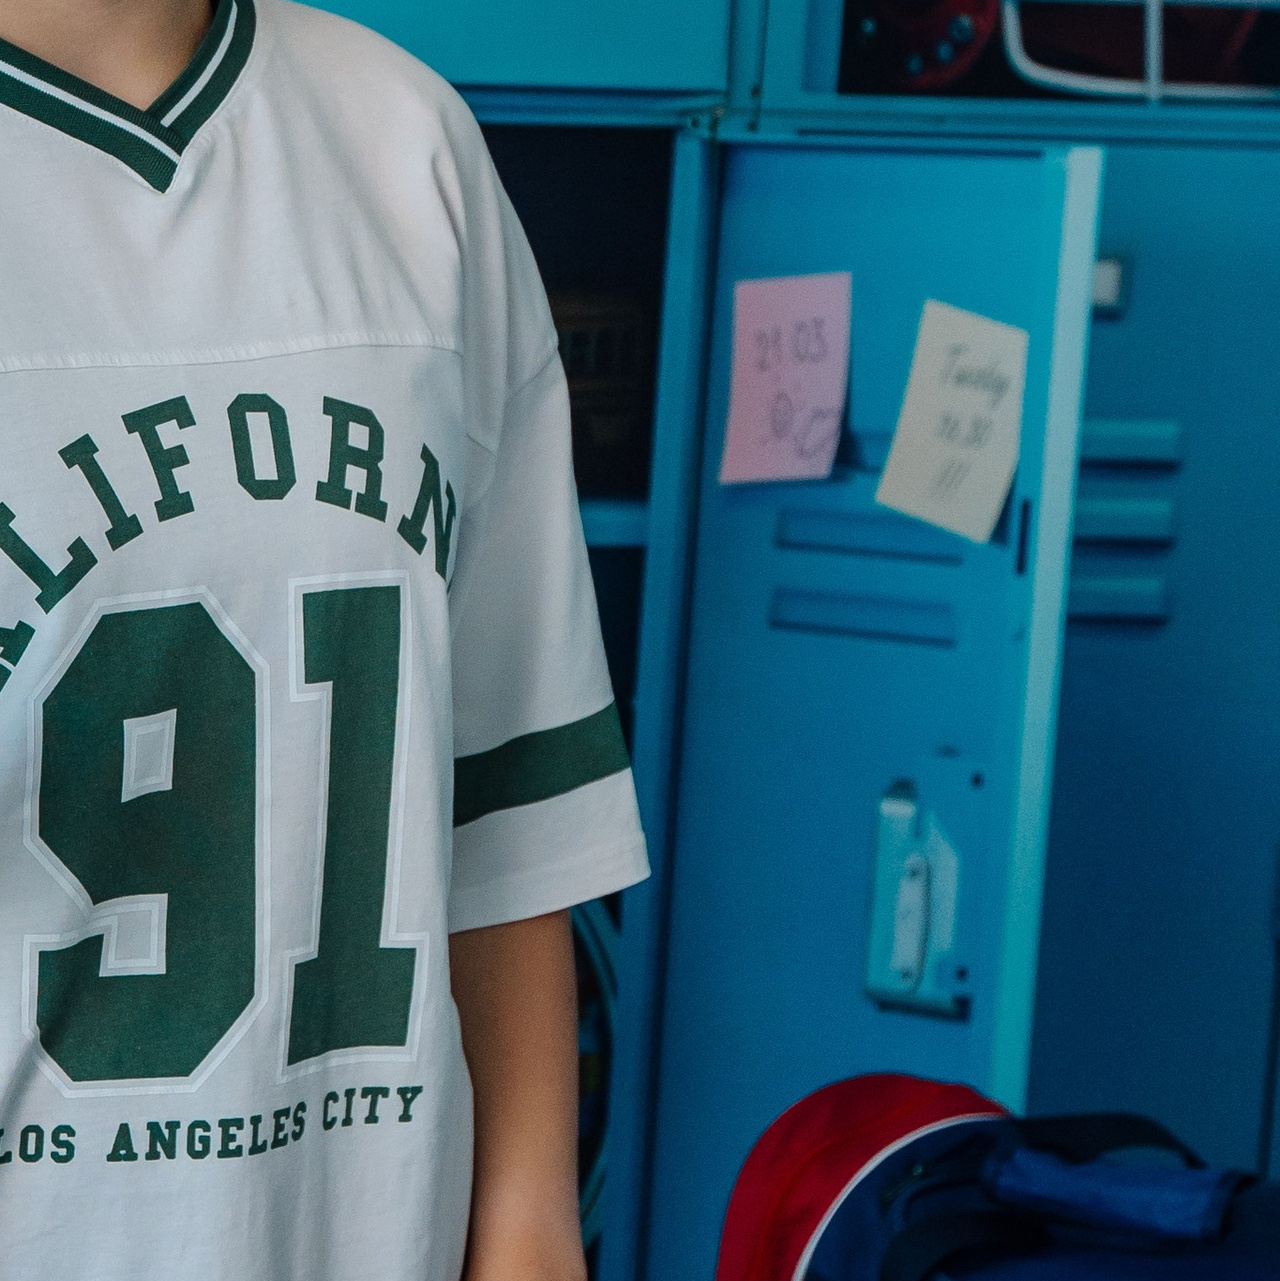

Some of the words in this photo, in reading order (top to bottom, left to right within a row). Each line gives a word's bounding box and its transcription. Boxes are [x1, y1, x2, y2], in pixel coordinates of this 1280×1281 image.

[22, 570, 430, 1099] 91
[106, 1101, 308, 1162] ANGELES
[322, 1086, 423, 1131] CITY
